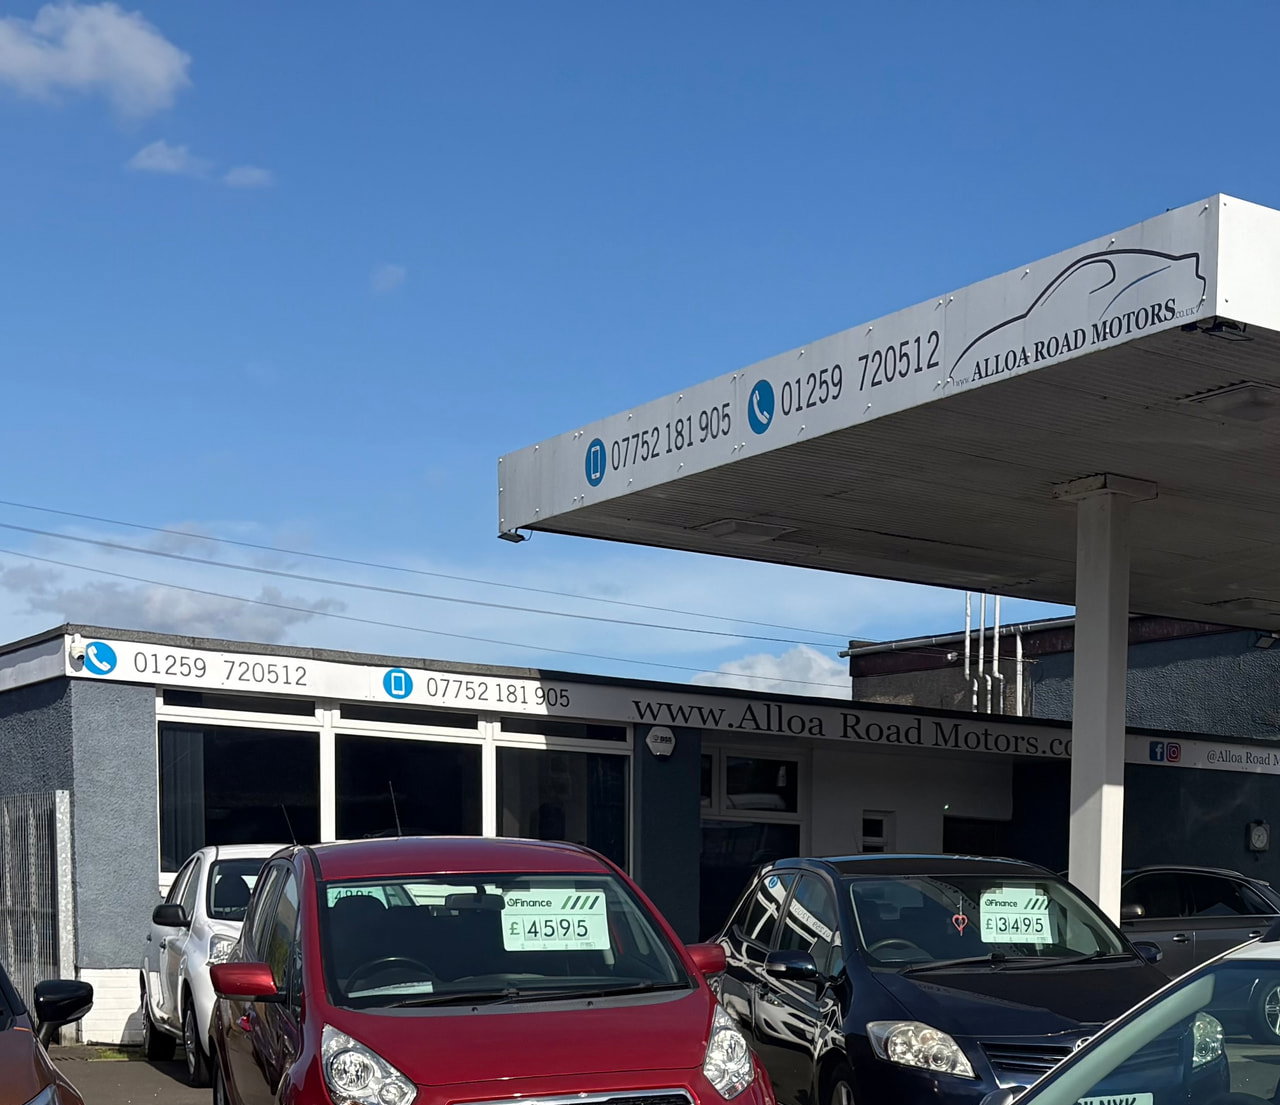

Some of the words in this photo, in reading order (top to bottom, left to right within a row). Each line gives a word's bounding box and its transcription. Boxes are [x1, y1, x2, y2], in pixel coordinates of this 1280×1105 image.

[971, 346, 1030, 382] ALLOA
[1033, 328, 1086, 363] ROAD
[1091, 298, 1176, 345] MOTORS
[781, 364, 843, 416] 01259
[858, 330, 939, 391] 720512
[611, 426, 660, 471] 07752
[666, 415, 693, 454] 181
[699, 402, 731, 443] 905
[134, 651, 206, 678] 01259
[223, 660, 307, 686] 720512
[426, 677, 489, 701] 07752
[496, 683, 528, 704] 181
[534, 686, 570, 708] 905
[839, 712, 924, 745] Road
[1206, 749, 1243, 764] @Alloa
[1245, 752, 1271, 765] Road
